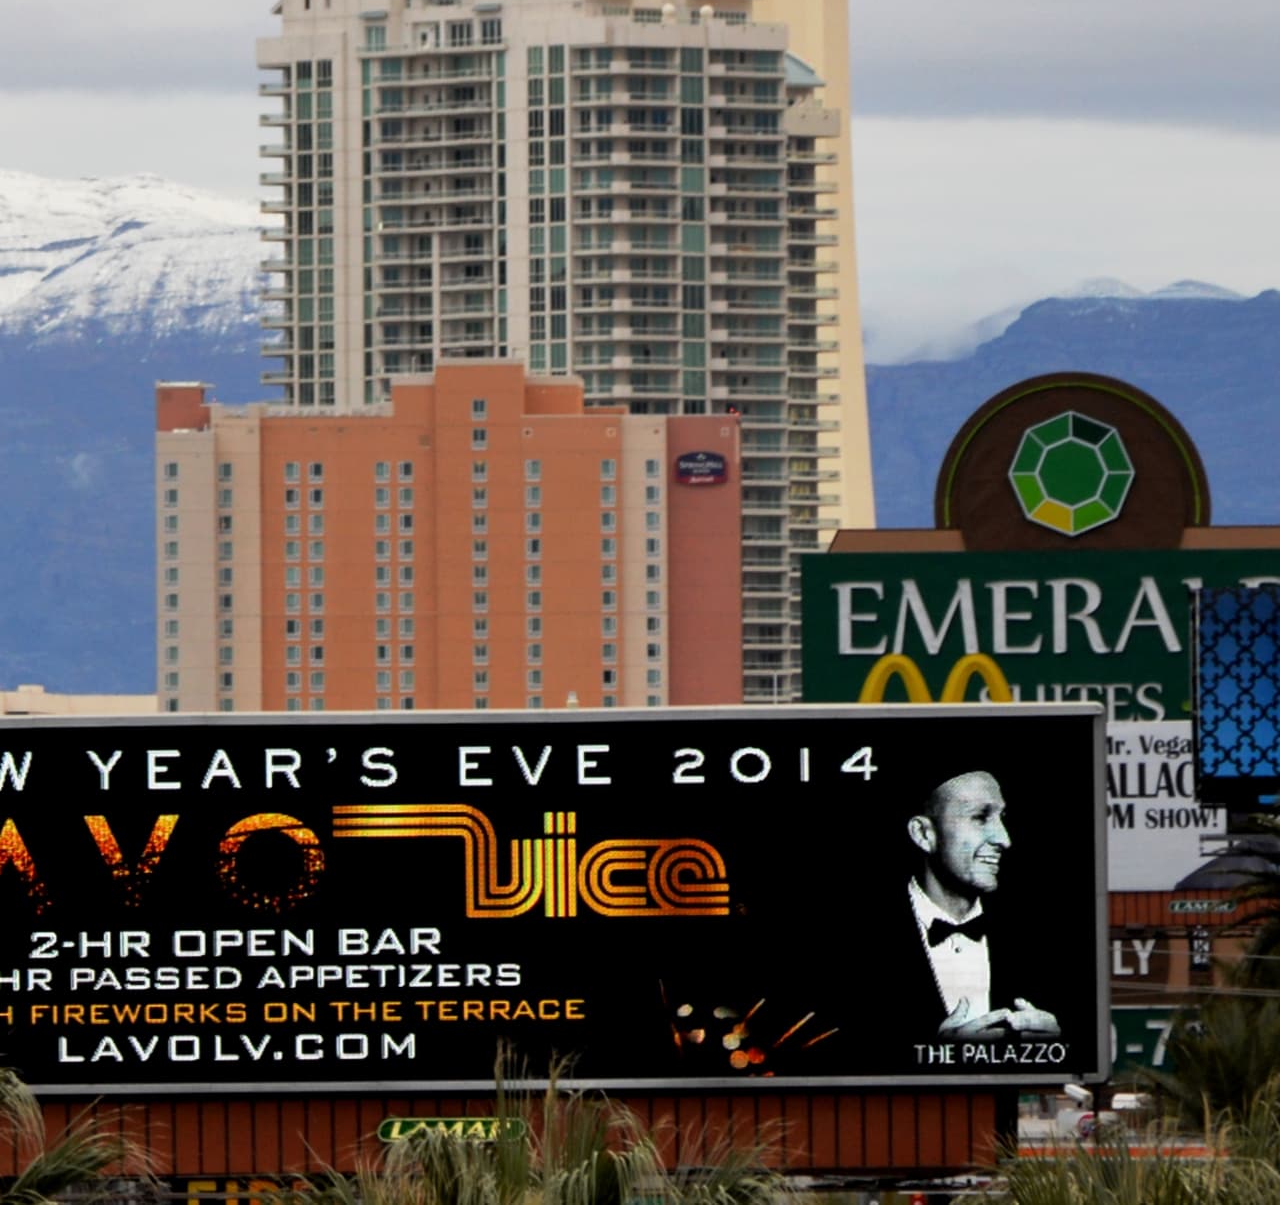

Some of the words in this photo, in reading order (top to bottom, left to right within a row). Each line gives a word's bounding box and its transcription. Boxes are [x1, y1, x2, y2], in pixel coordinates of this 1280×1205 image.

[87, 747, 398, 790] YEAR'S
[459, 745, 611, 786] EVE
[672, 746, 878, 785] 2014
[1145, 807, 1219, 829] SHOW!
[28, 931, 151, 959] 2-HR
[172, 929, 315, 957] OPEN
[338, 927, 441, 956] BAR
[70, 966, 242, 991] PASSED
[256, 963, 522, 989] APPETIZERS
[30, 1003, 247, 1025] FIREWORKS
[263, 1002, 316, 1023] ON
[329, 1001, 403, 1022] THE
[415, 999, 586, 1021] TERRACE
[58, 1033, 417, 1063] LAVOLV.COM
[913, 1044, 955, 1064] THE
[962, 1043, 1067, 1063] PALAZZO
